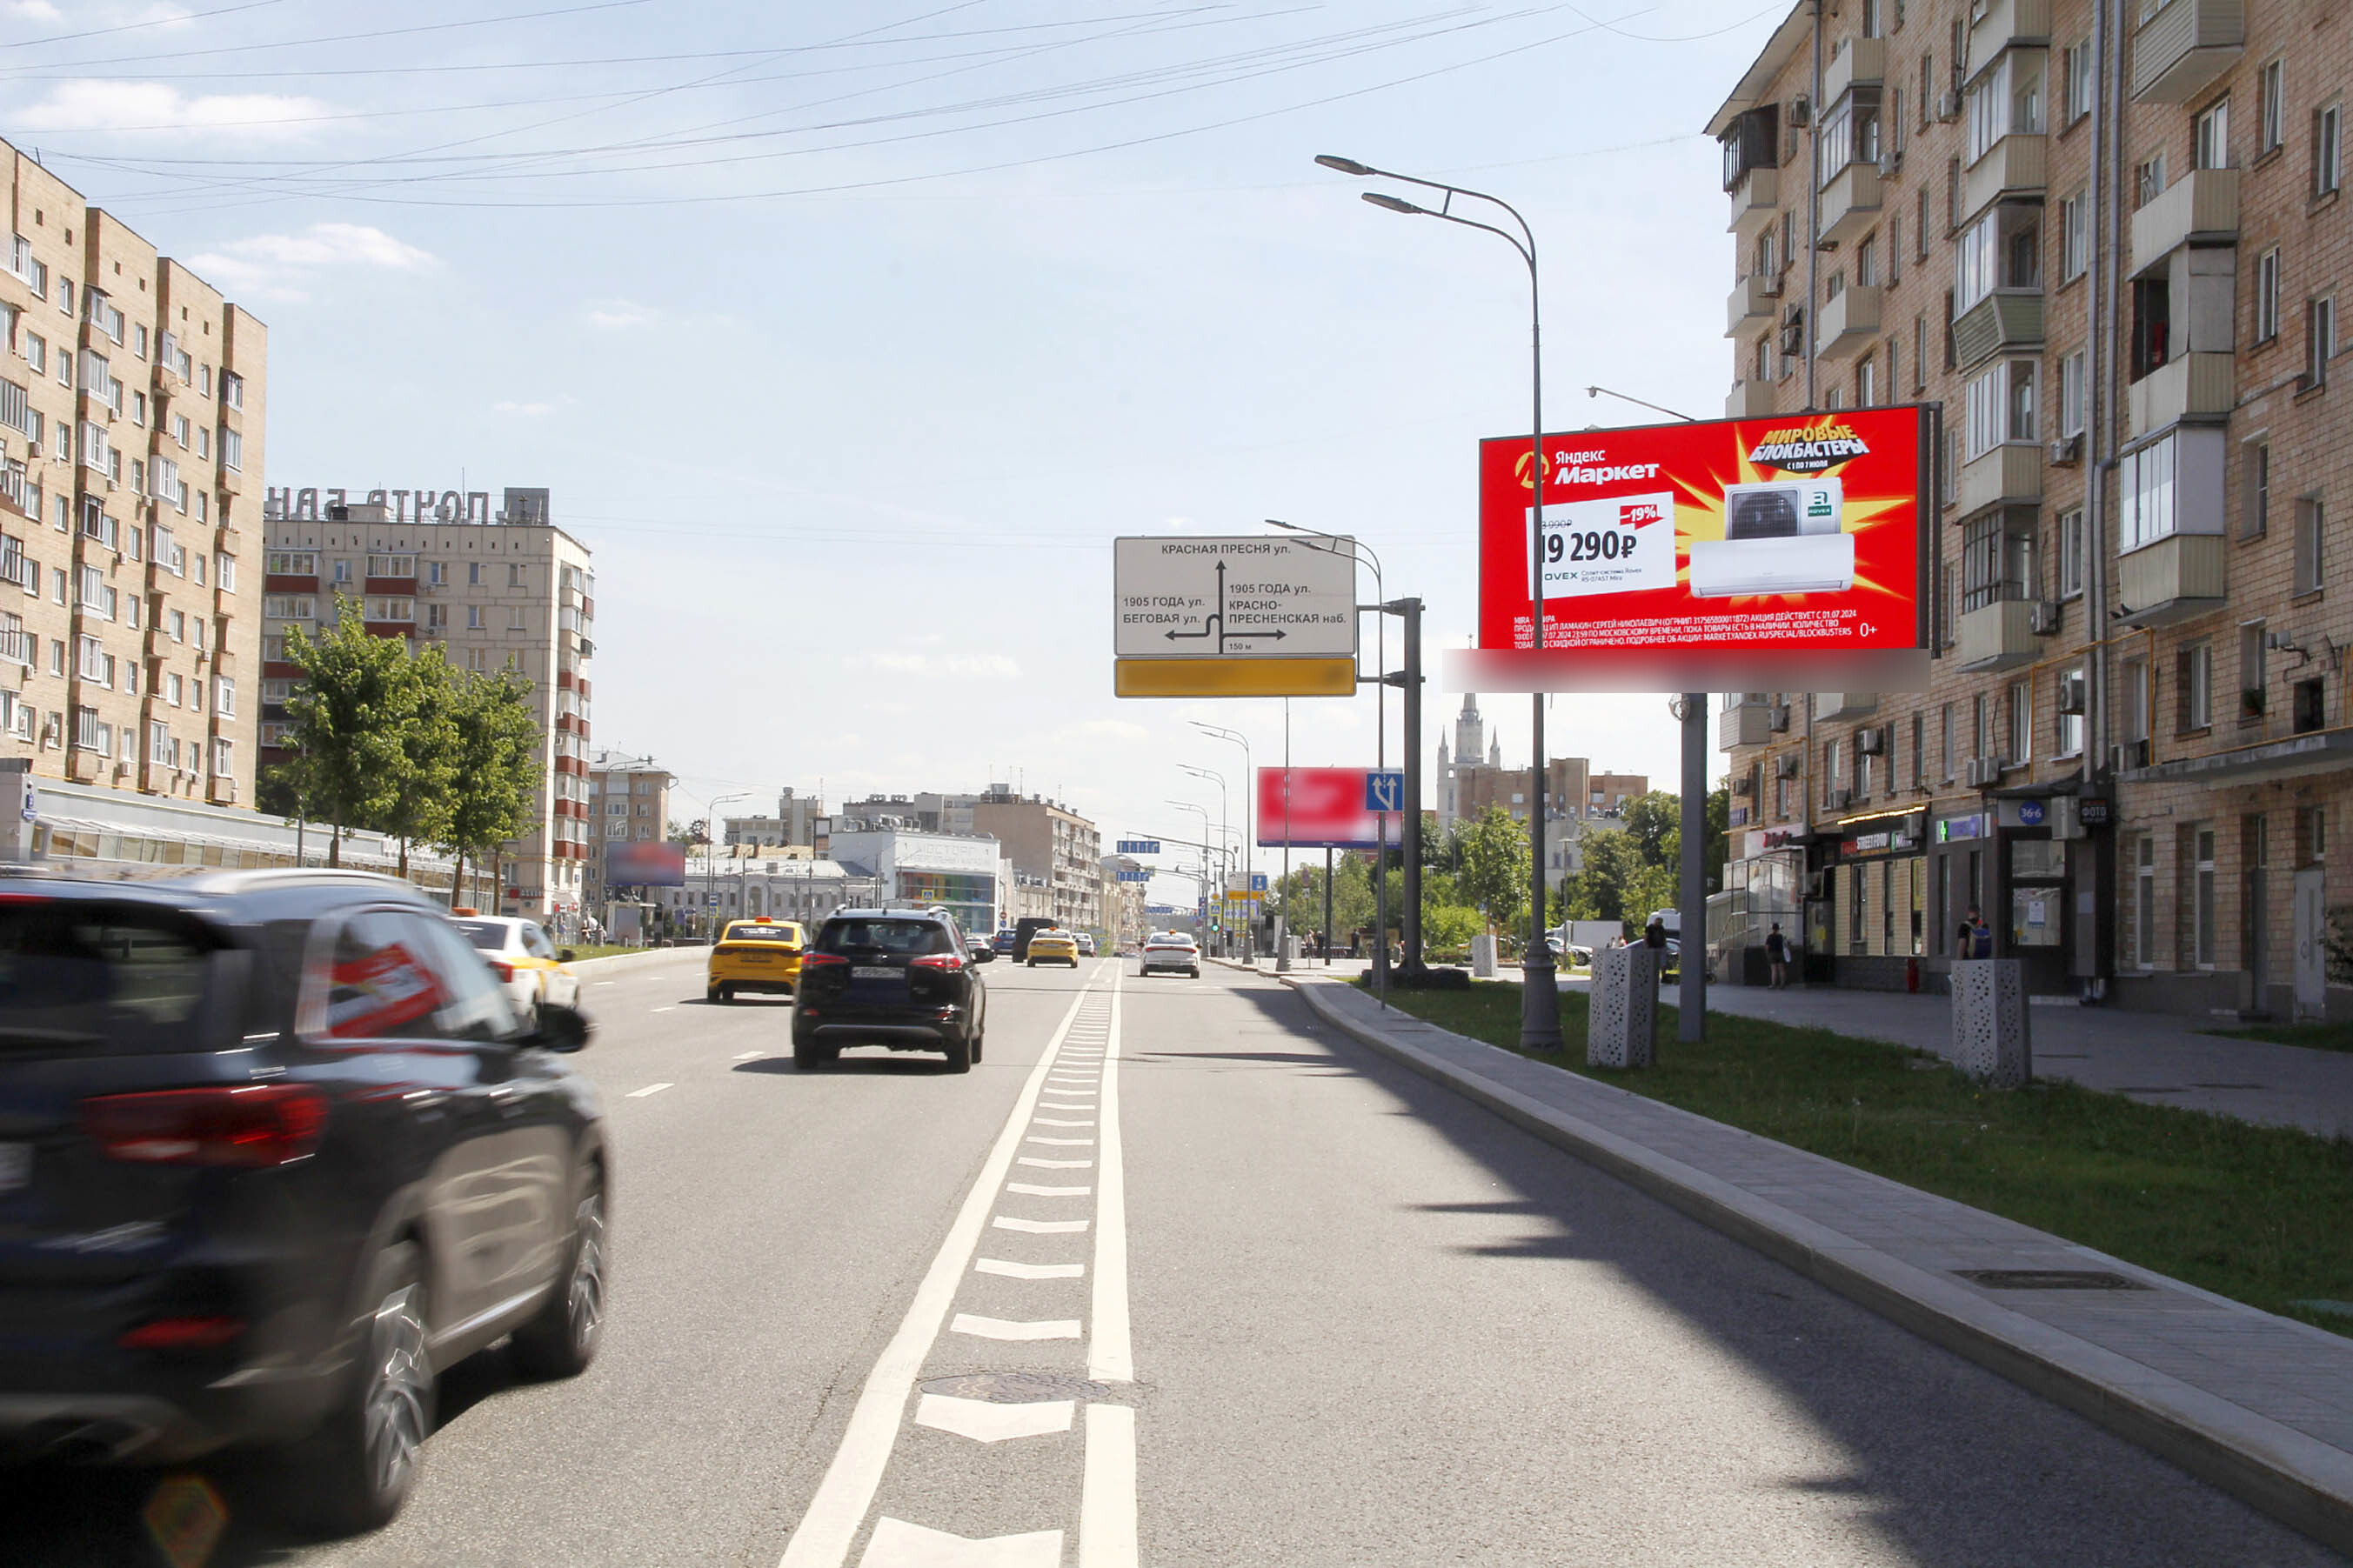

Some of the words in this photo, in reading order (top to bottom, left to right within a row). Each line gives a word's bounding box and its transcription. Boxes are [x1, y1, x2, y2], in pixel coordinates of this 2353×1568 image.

[1760, 424, 1858, 445] МИРОВЫЕ
[1748, 437, 1871, 462] БЛОКБАСТЕРЫ
[1555, 450, 1606, 464] Яндекс
[1795, 461, 1804, 470] ПО
[1554, 464, 1660, 485] Маркет
[1161, 544, 1218, 554] КРАСНАЯ
[1221, 544, 1270, 554] ПРЕСНЯ
[1274, 546, 1291, 555] ул.
[1544, 572, 1578, 581] OVEX
[1229, 584, 1255, 593] 1905
[1259, 584, 1290, 595] ГОДА
[1294, 586, 1311, 595] ул.
[1123, 598, 1149, 607] 1905
[1153, 597, 1184, 608] ГОДА
[1188, 599, 1205, 608] ул.
[1229, 600, 1281, 611] КРАСНО-
[1123, 614, 1180, 624] БЕГОВАЯ
[1184, 616, 1200, 624] ул.
[1229, 614, 1319, 624] ПРЕСНЕНСКАЯ
[1322, 614, 1347, 624] наб.
[1860, 623, 1878, 637] 0+
